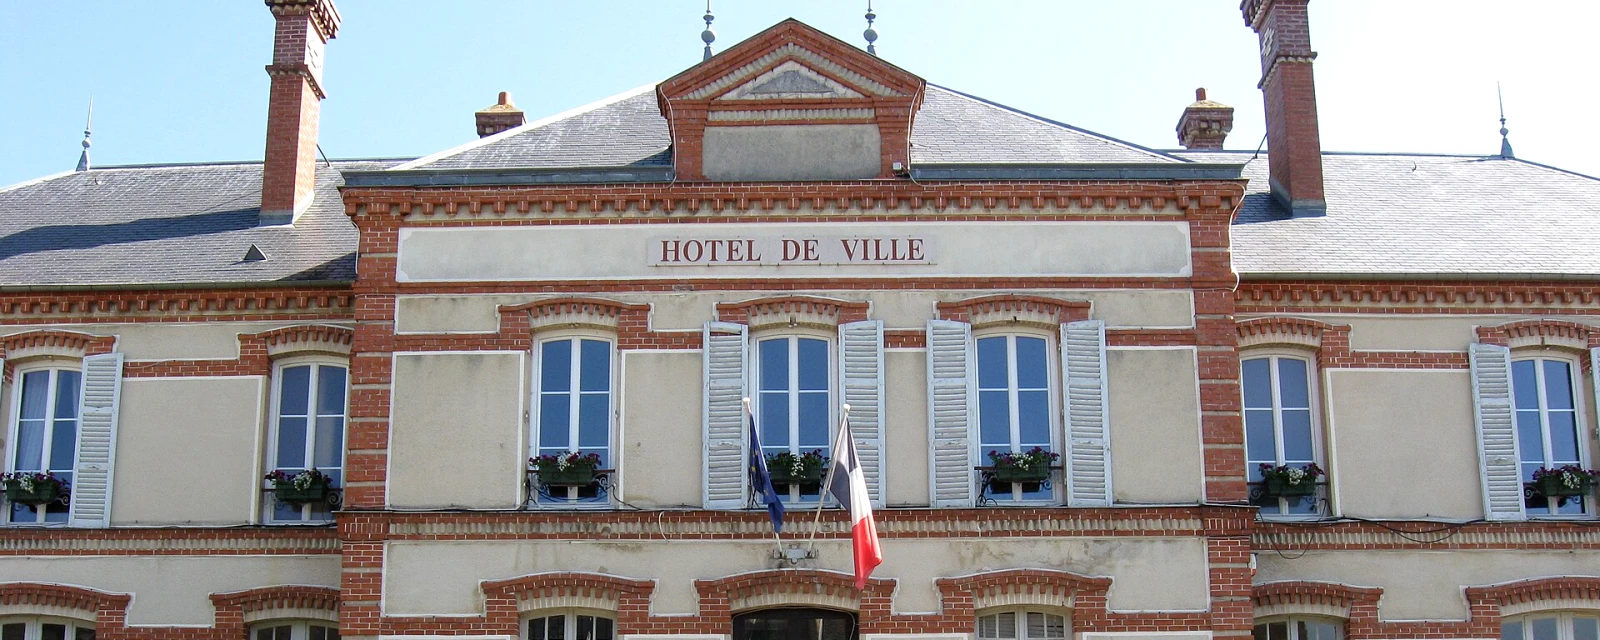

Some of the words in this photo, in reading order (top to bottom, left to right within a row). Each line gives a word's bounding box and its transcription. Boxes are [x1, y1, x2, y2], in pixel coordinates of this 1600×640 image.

[661, 239, 761, 262] HOTEL
[781, 239, 819, 262] DE
[841, 238, 925, 261] VILLE
